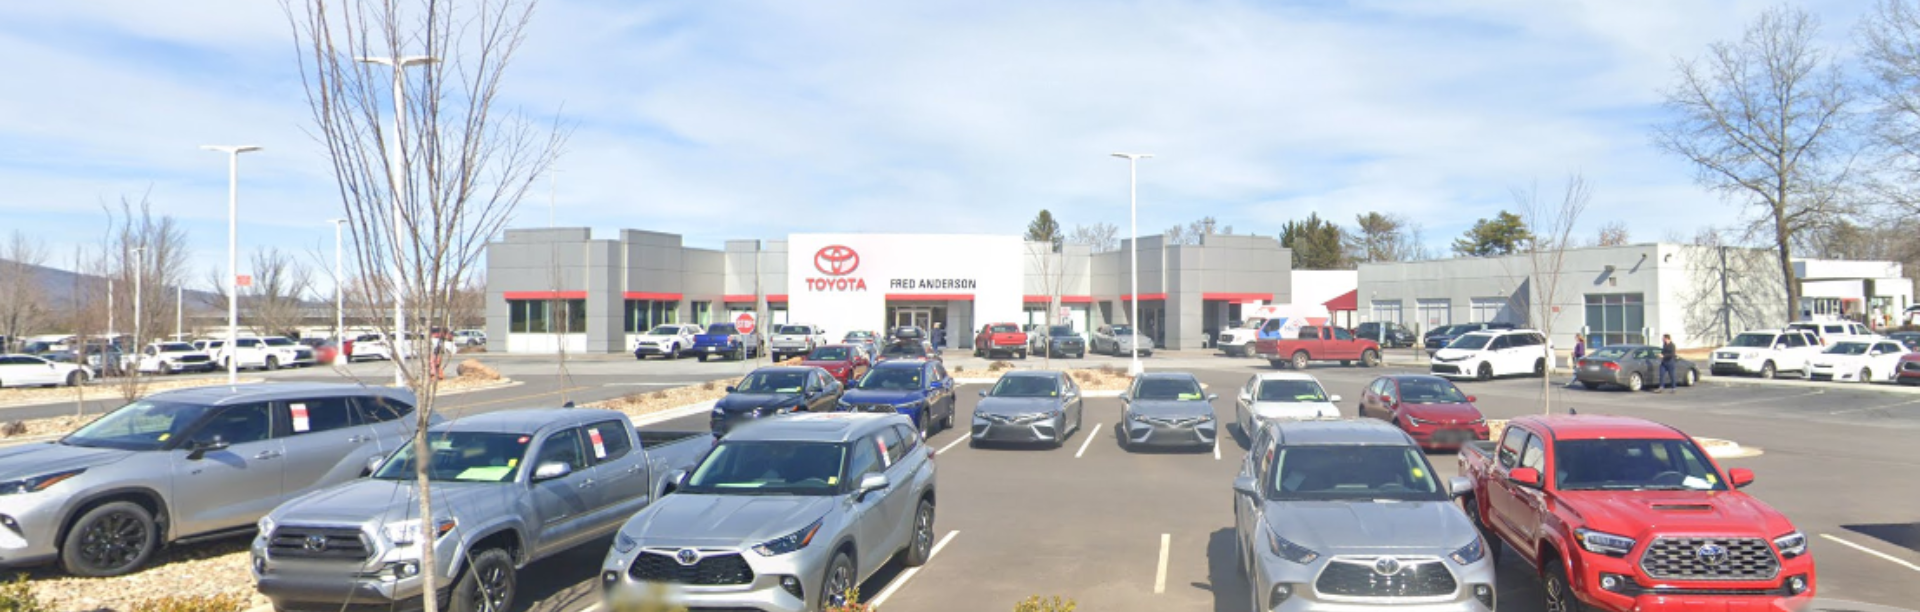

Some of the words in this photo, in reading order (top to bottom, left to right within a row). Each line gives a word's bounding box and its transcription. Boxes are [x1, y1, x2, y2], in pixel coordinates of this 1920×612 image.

[805, 278, 867, 291] TOYOTA
[890, 279, 916, 289] FRED
[918, 279, 976, 289] ANDERSON
